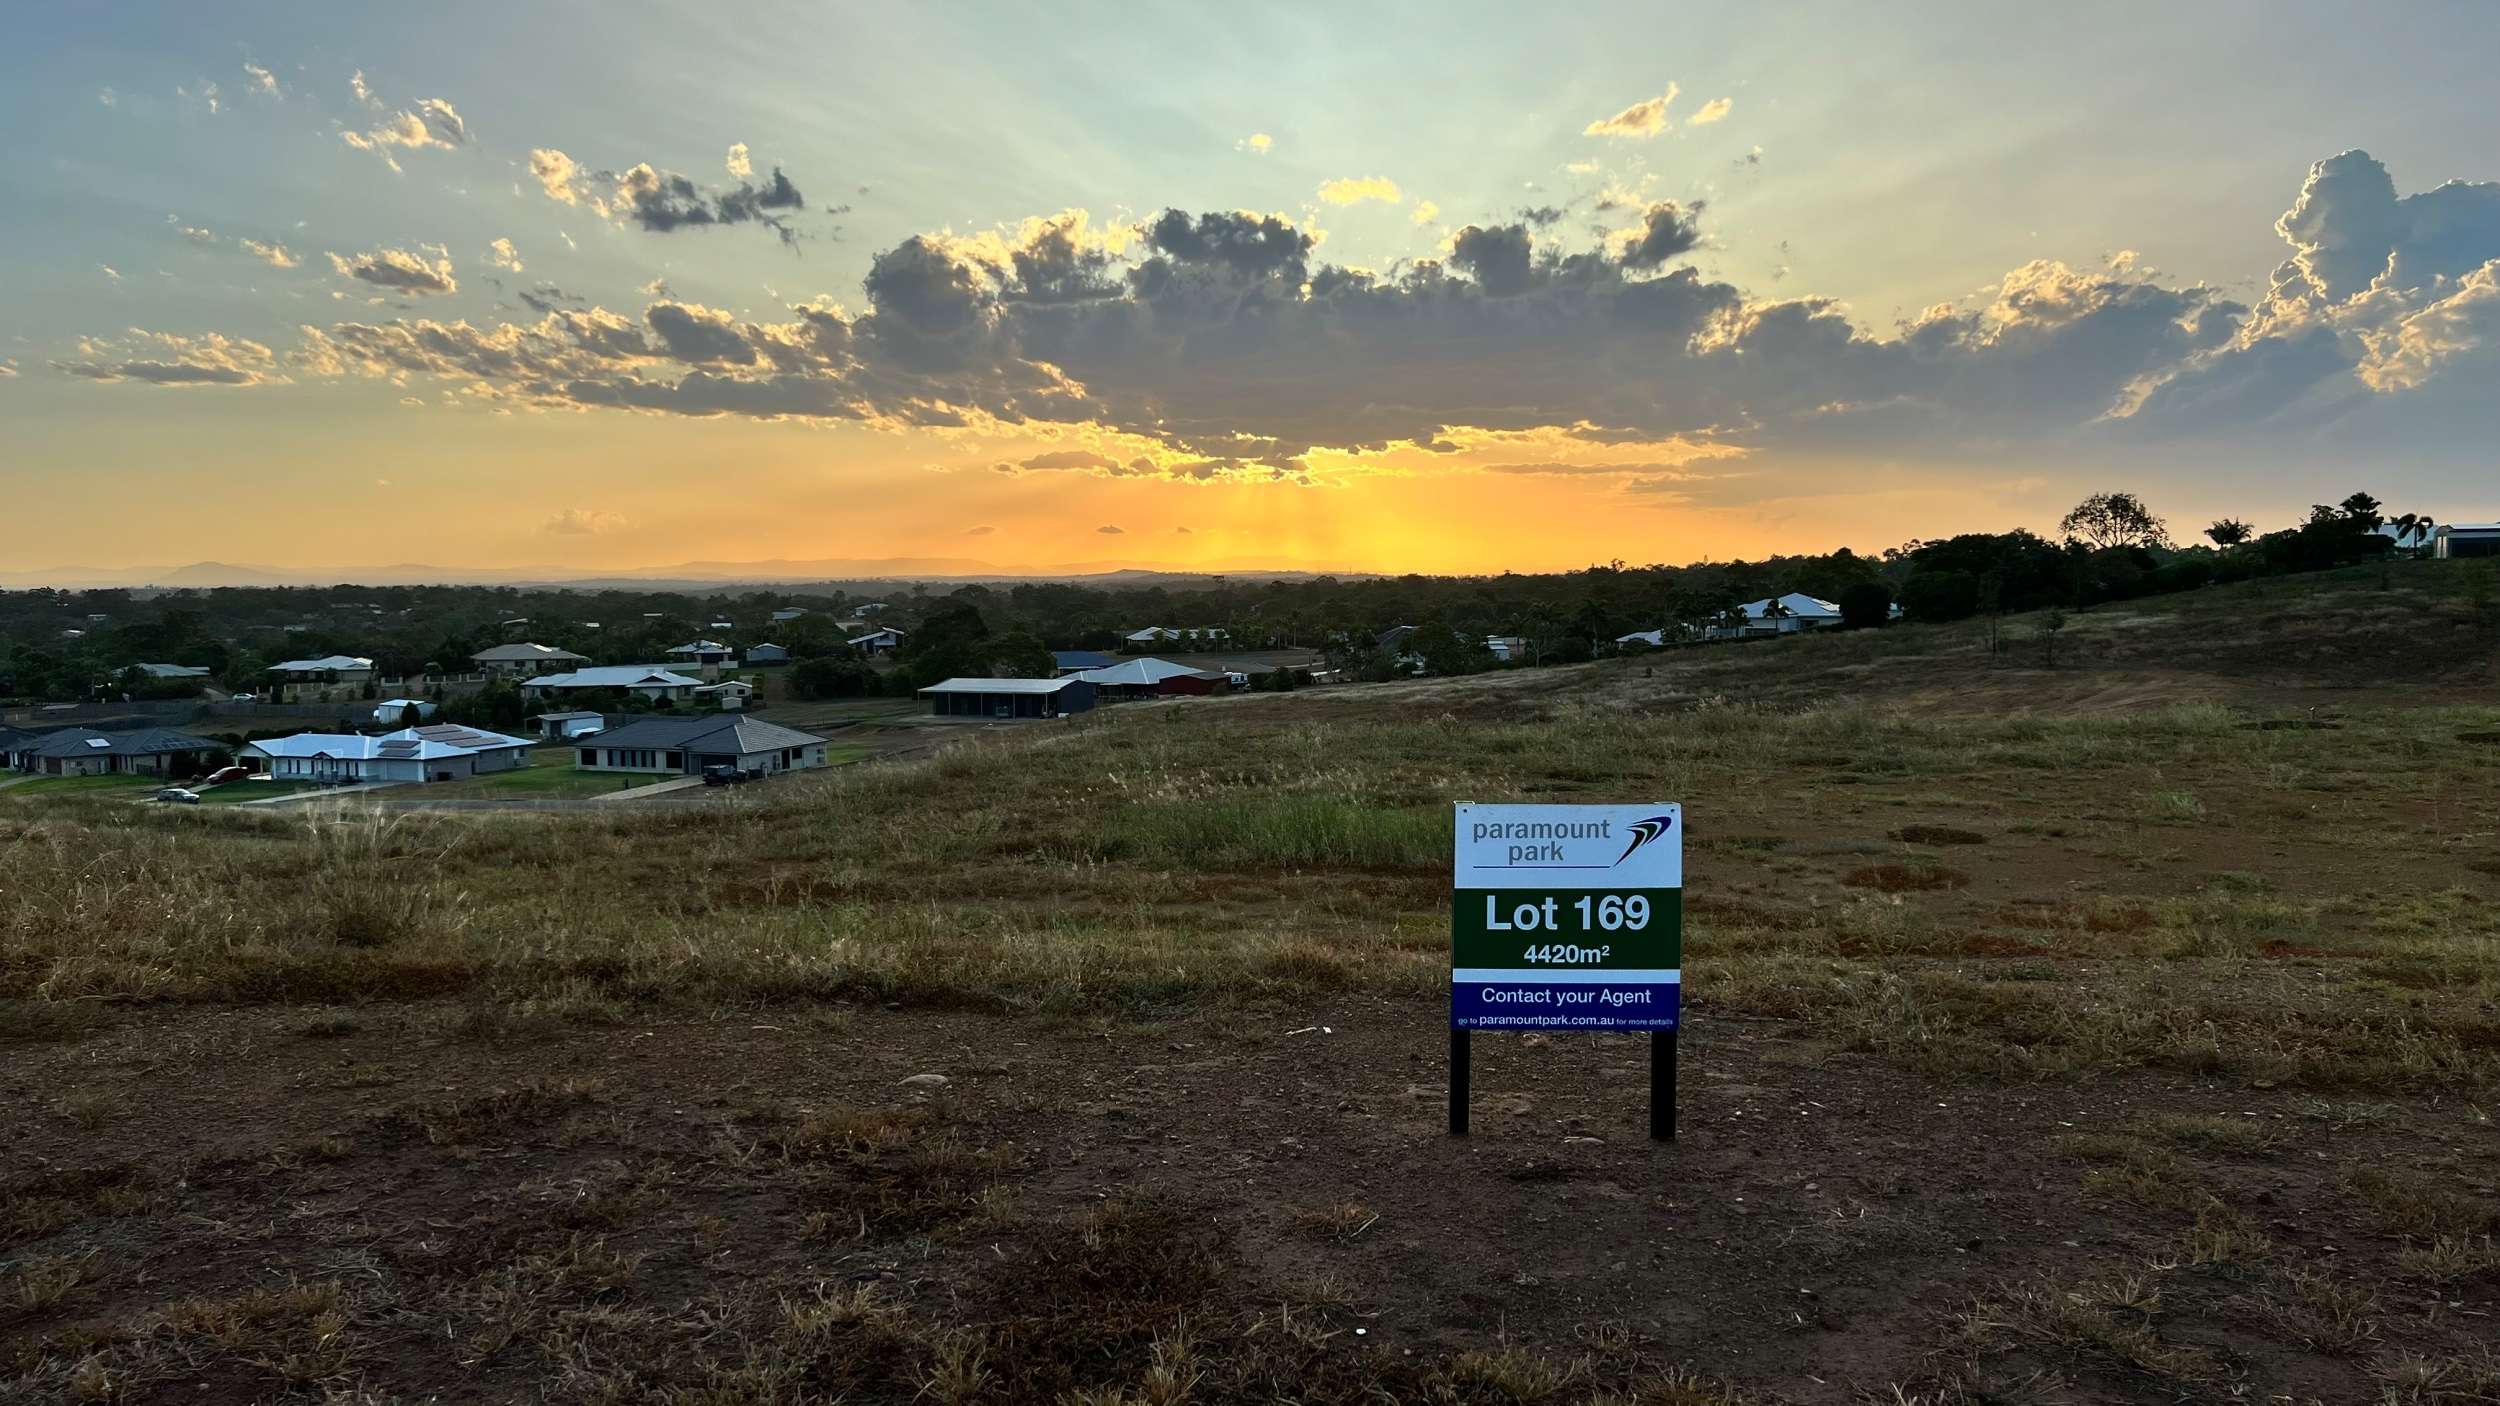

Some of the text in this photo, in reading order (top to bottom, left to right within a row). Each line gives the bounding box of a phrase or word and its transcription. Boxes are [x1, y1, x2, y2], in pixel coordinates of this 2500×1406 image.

[1473, 820, 1611, 843] paramount
[1508, 841, 1564, 865] park
[1486, 895, 1650, 931] Lot 169
[1523, 944, 1610, 963] 4420m²
[1482, 987, 1652, 1007] Contact your Agent
[1458, 1018, 1468, 1027] go
[1479, 1015, 1615, 1027] paramountpark.com.au
